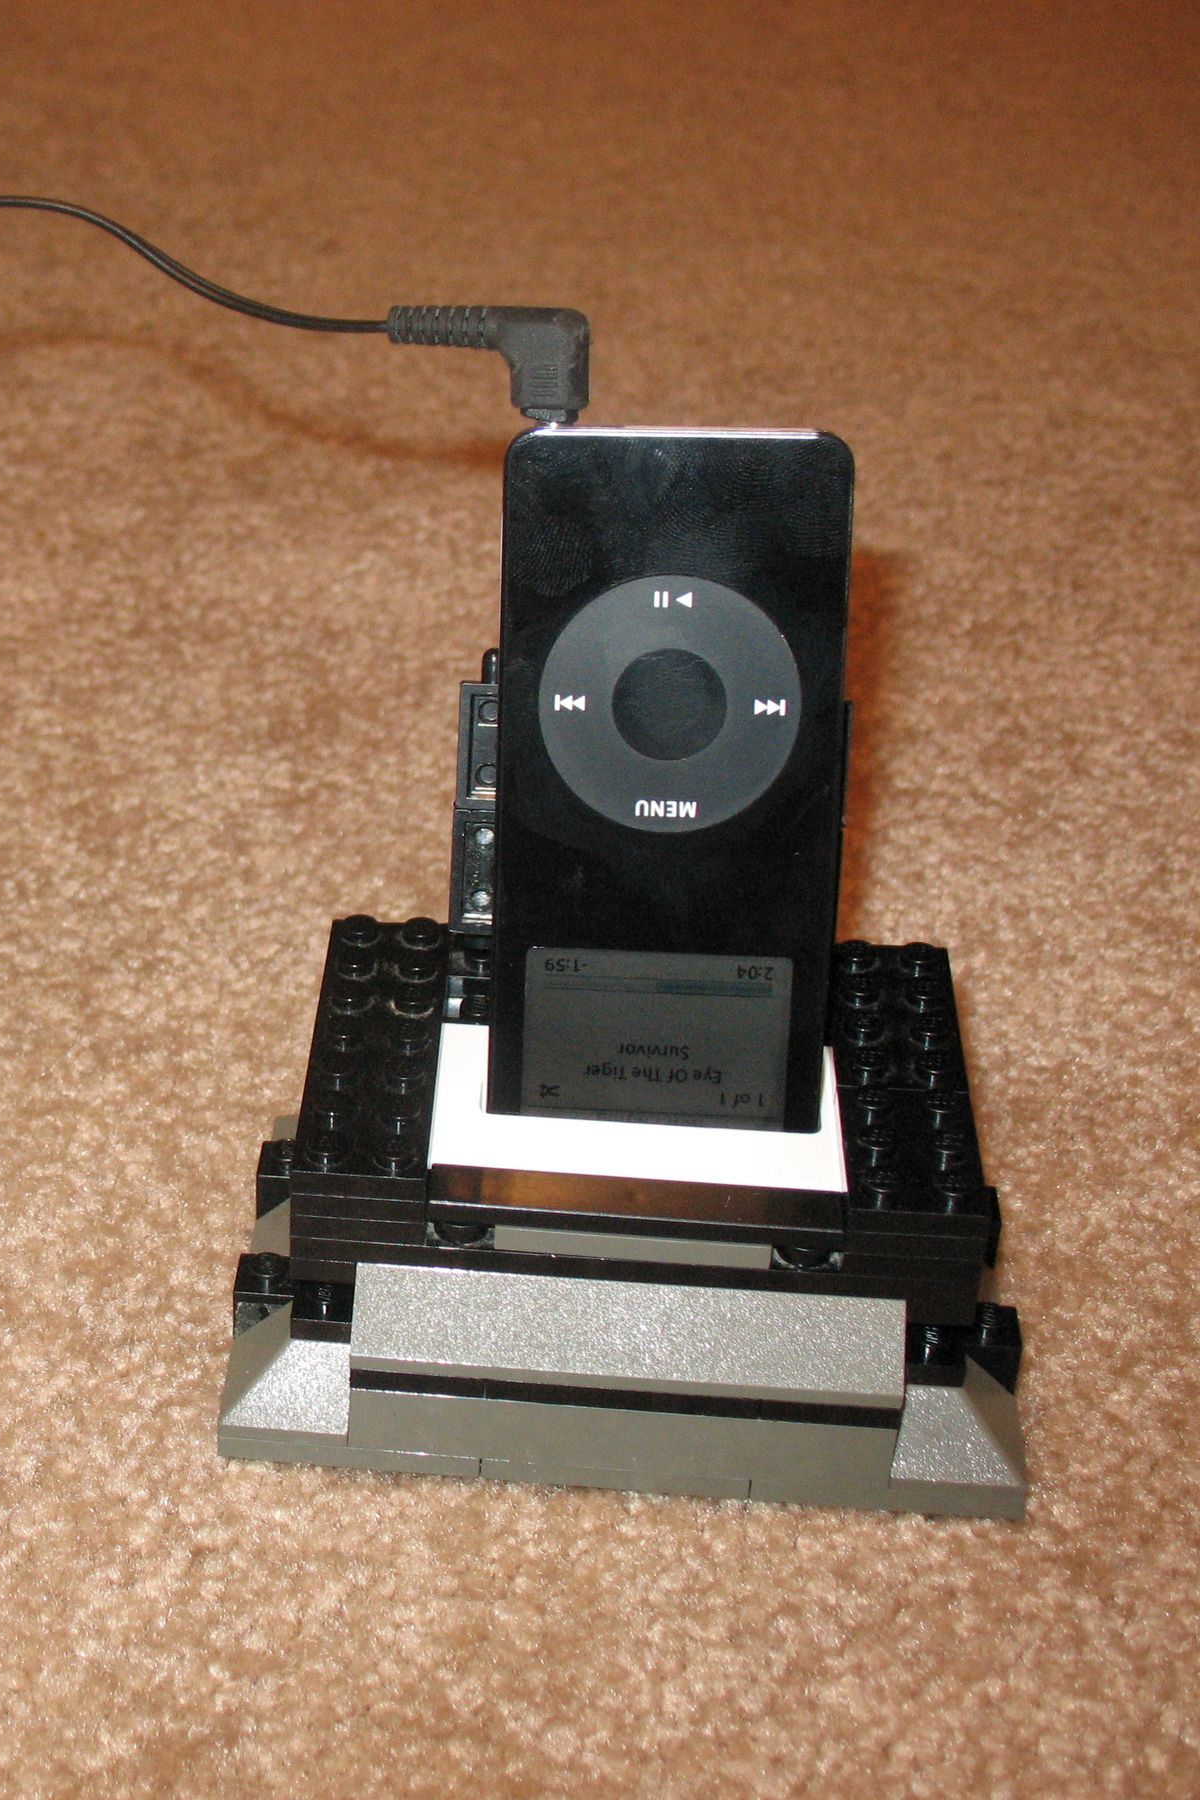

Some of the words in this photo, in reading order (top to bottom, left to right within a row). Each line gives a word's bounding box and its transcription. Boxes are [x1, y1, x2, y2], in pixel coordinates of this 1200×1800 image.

[634, 799, 698, 818] MENU
[545, 957, 589, 973] -1:59
[737, 964, 774, 980] 2:04
[618, 1043, 690, 1058] Survivor
[584, 1063, 627, 1080] Tiger
[632, 1067, 661, 1082] The
[667, 1068, 688, 1083] Of
[692, 1065, 722, 1085] Eye
[719, 1092, 726, 1106] 1
[733, 1093, 751, 1108] of
[758, 1093, 765, 1107] 1
